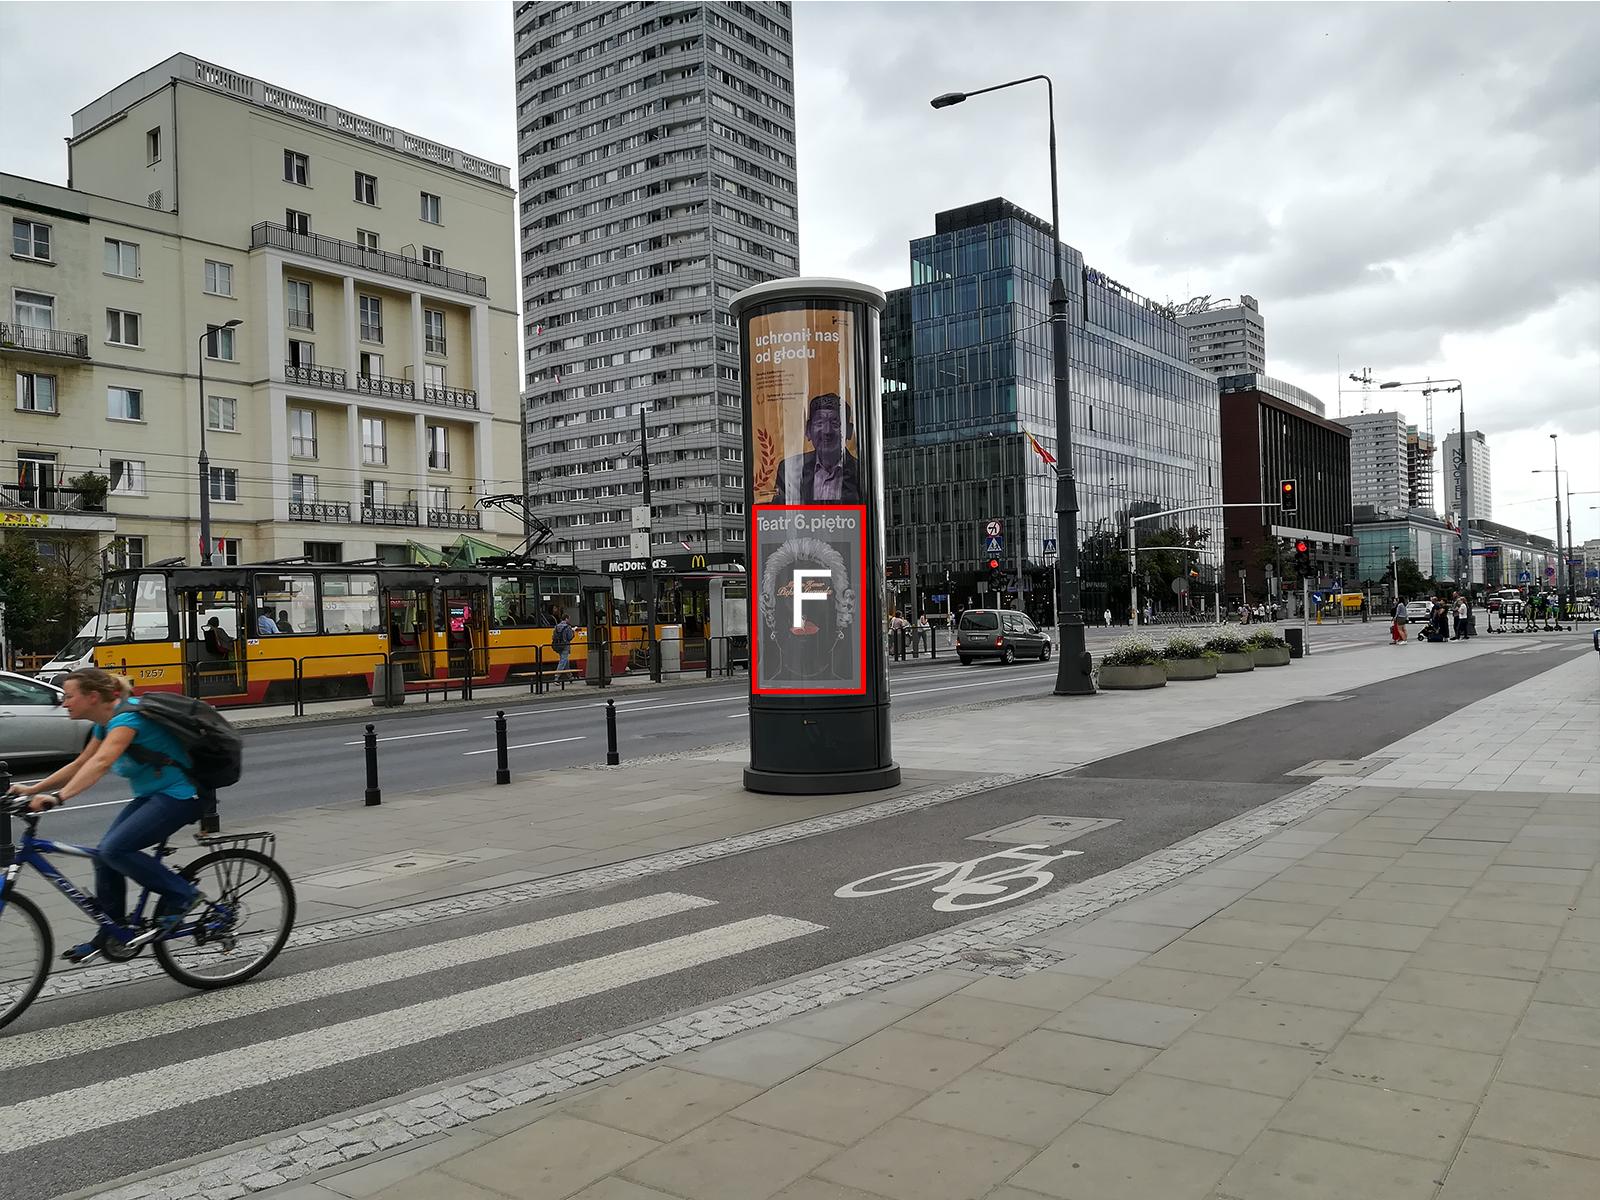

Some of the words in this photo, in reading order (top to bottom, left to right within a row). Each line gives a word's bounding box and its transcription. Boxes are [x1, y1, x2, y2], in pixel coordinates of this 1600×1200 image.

[755, 328, 811, 347] uchronił
[815, 331, 840, 342] nas
[755, 349, 770, 363] od
[774, 345, 815, 364] głodu
[757, 516, 791, 531] Teatr
[608, 558, 667, 573] McDond's
[140, 669, 165, 679] 1257
